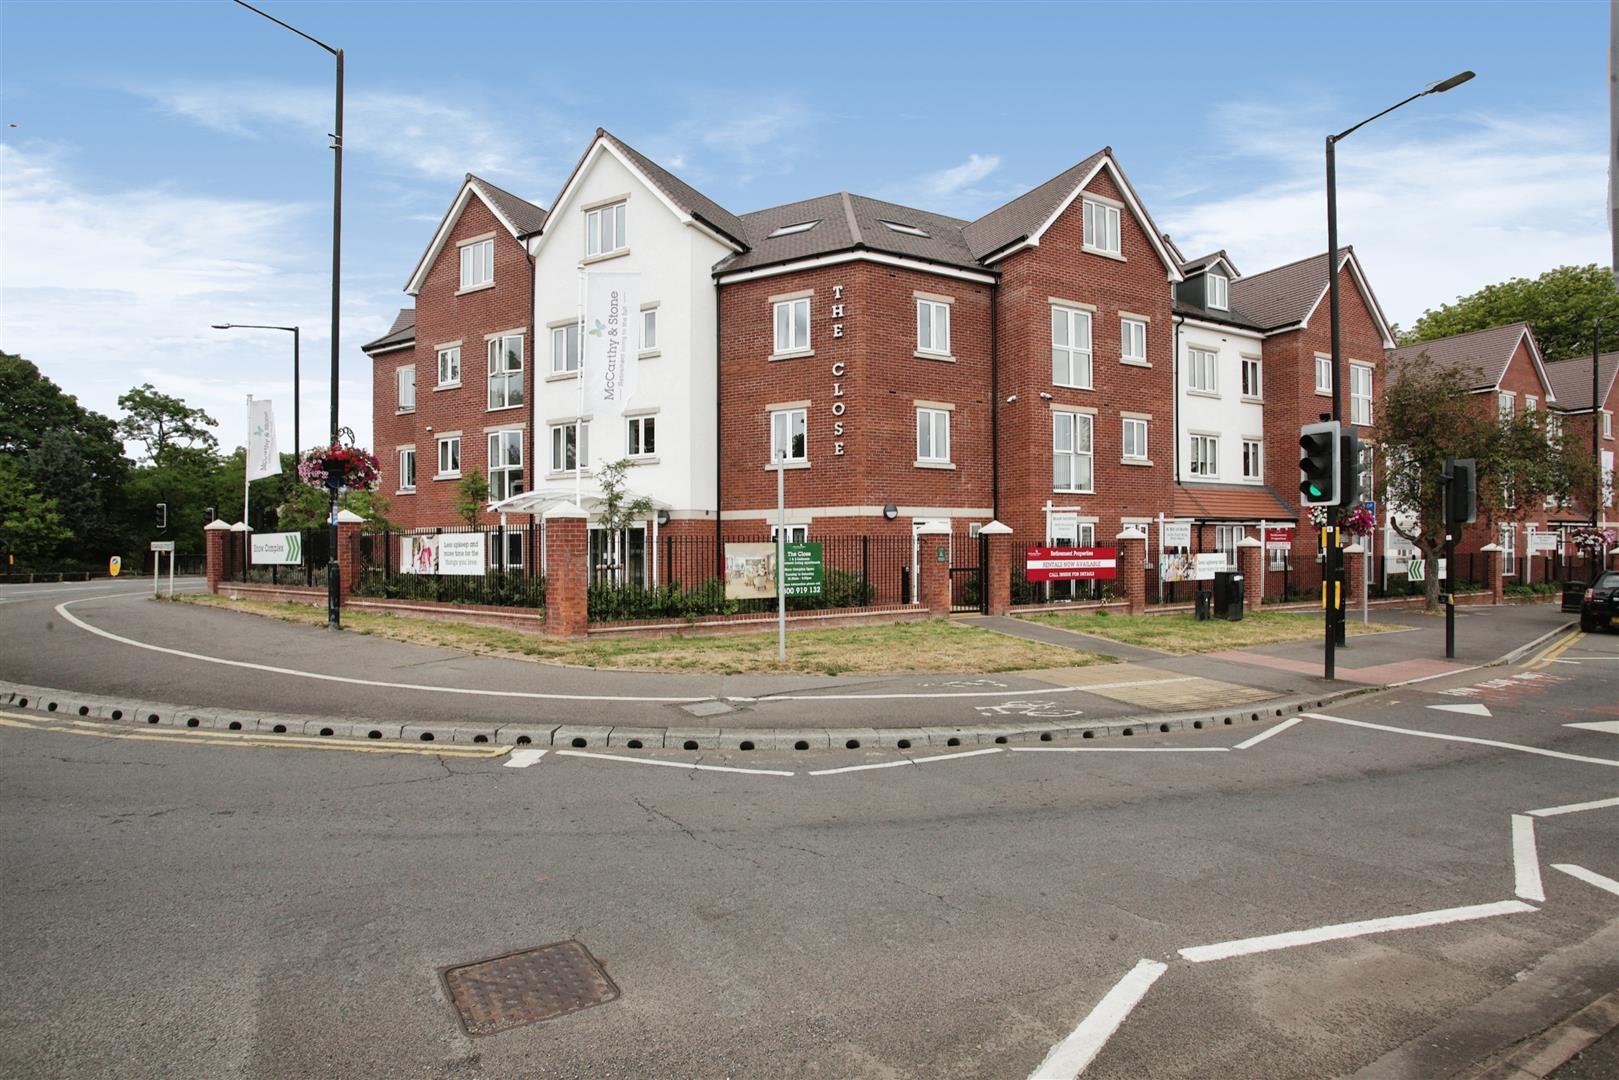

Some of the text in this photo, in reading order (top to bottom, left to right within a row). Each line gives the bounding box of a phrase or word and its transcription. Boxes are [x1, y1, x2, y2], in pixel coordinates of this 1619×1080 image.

[603, 290, 620, 400] McCarthy & Stone
[831, 285, 845, 456] THE CLOSE
